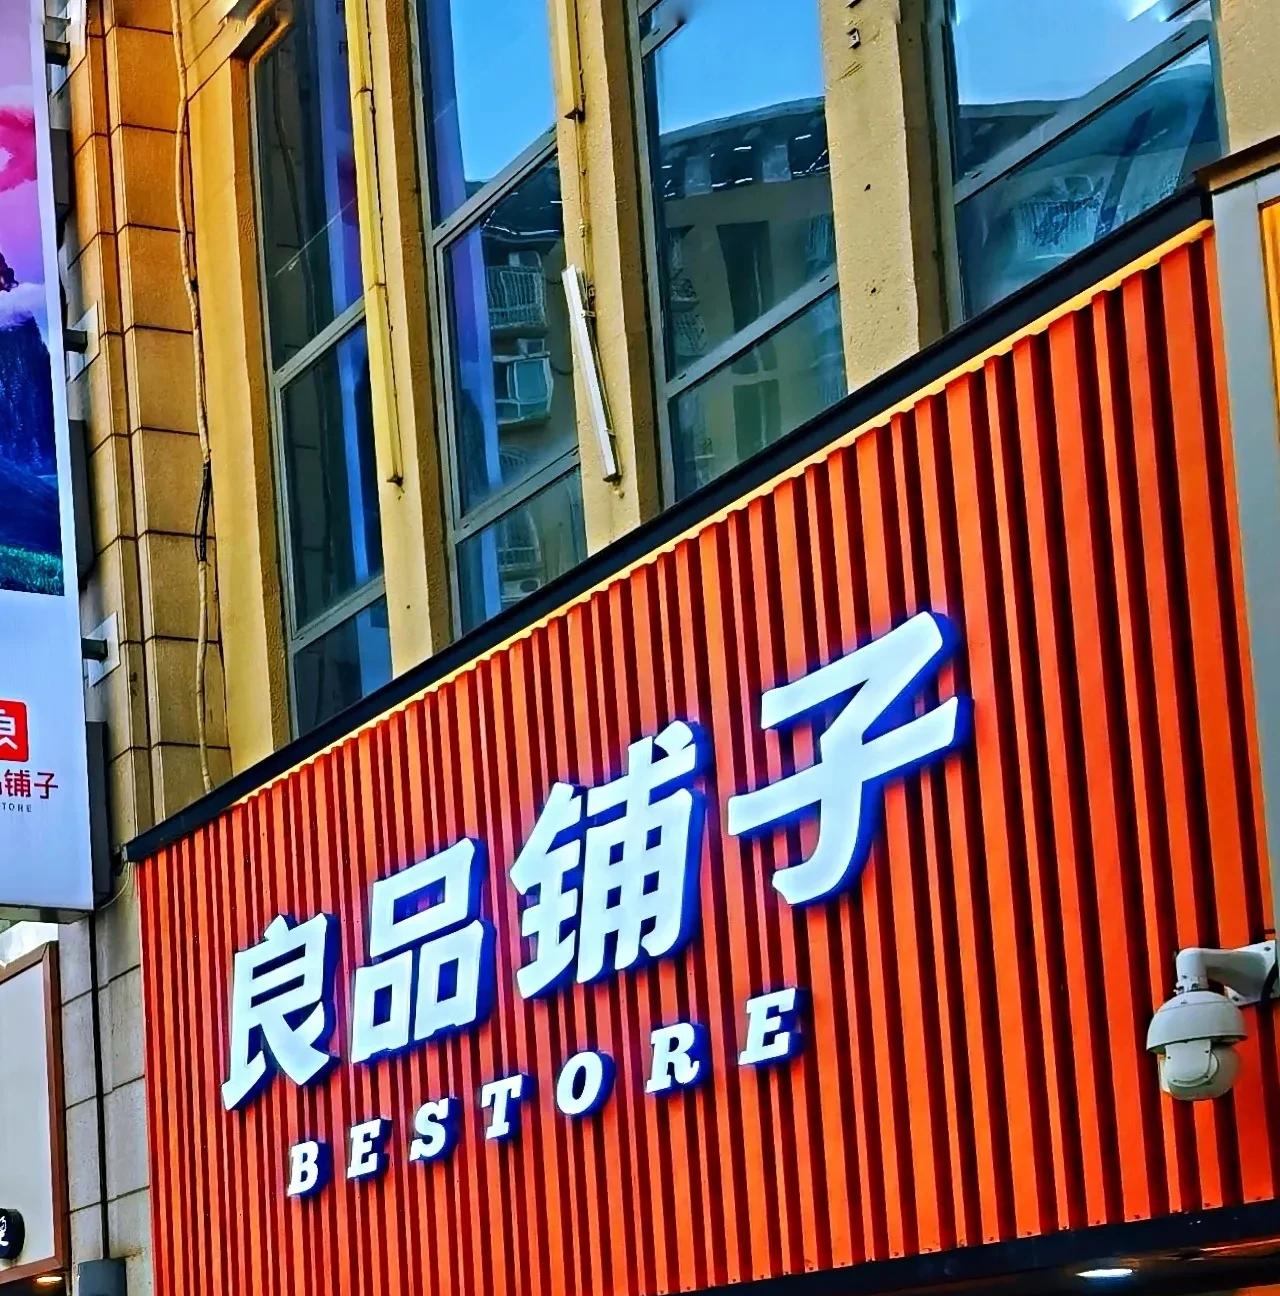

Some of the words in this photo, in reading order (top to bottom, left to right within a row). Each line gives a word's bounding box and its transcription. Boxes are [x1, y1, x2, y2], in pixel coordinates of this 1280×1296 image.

[220, 608, 962, 1112] 良品铺子
[287, 986, 801, 1196] BESTORE
